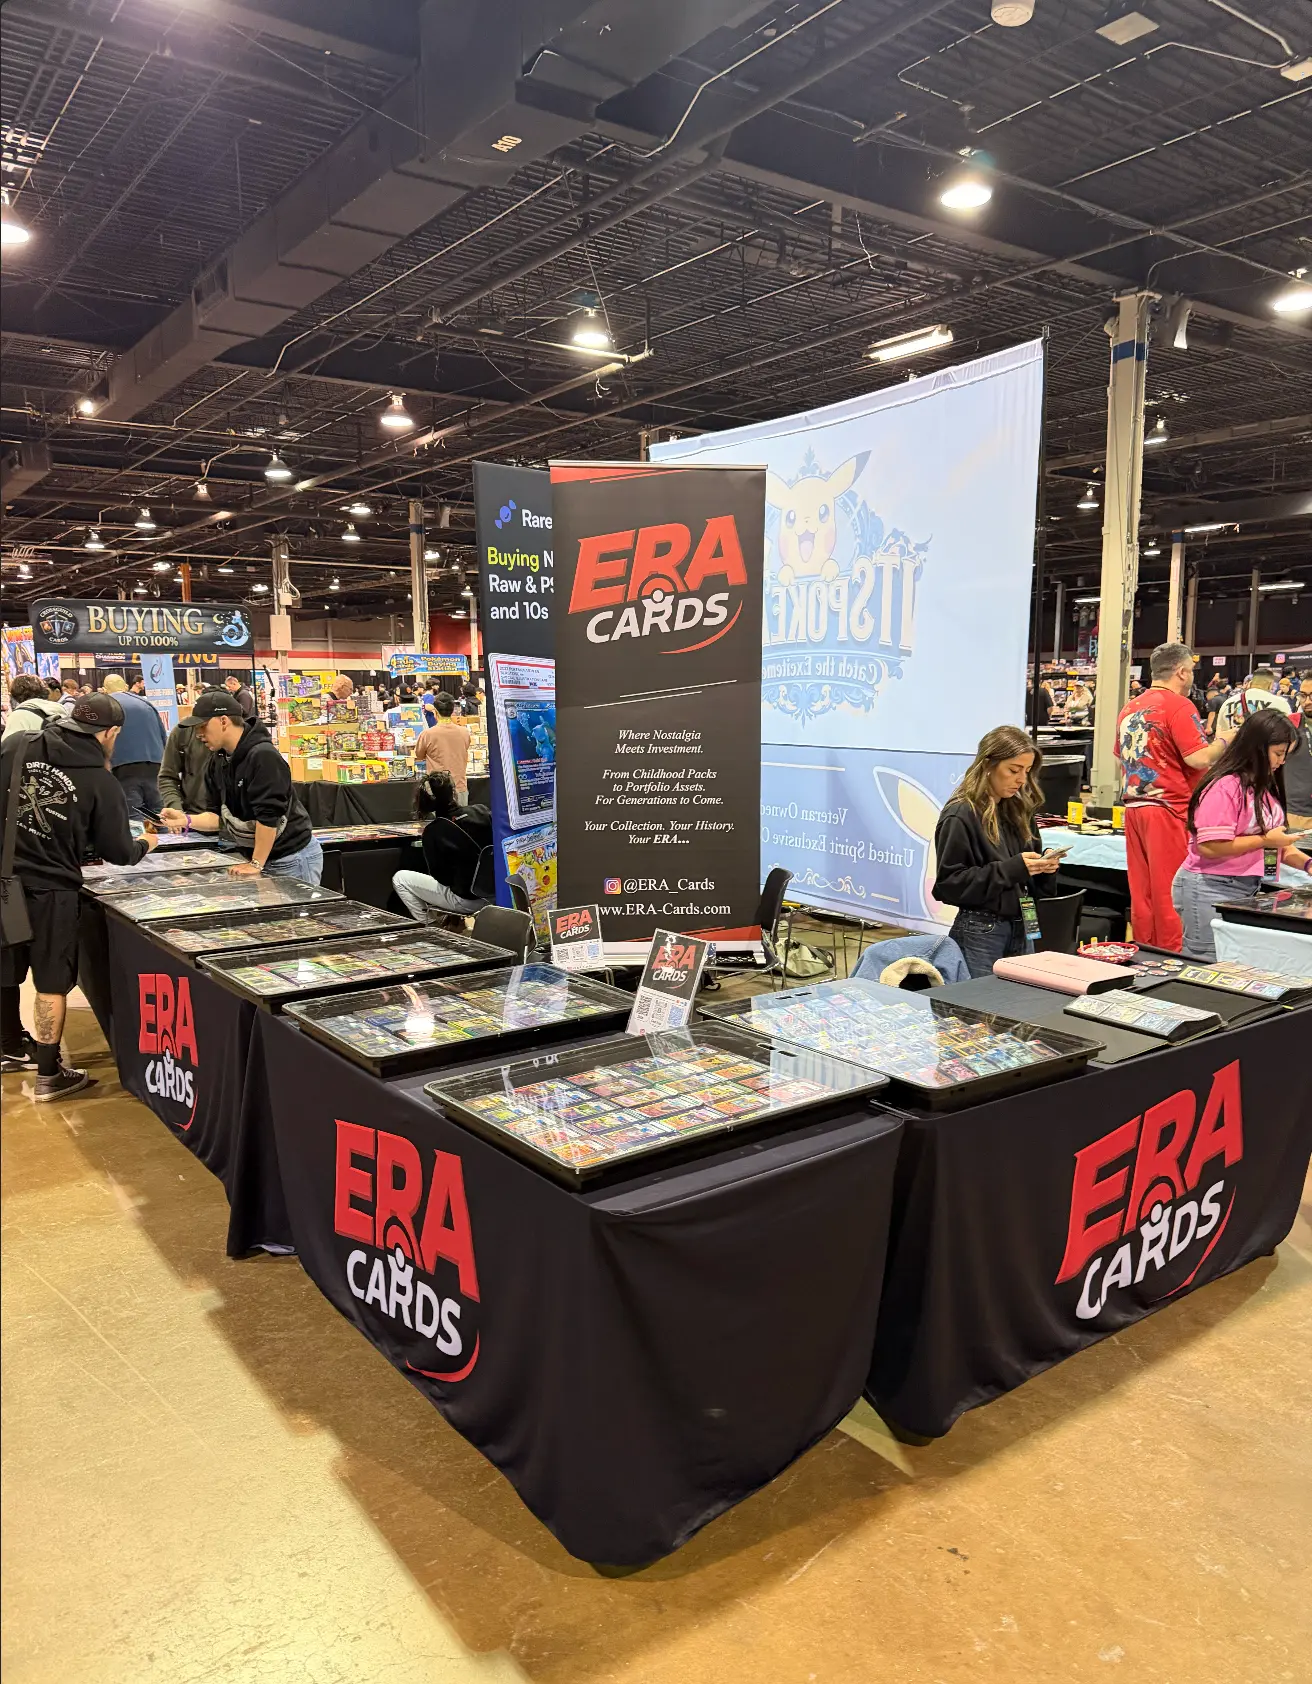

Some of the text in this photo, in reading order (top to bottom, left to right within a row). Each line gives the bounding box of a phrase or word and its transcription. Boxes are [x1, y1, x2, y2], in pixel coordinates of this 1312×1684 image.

[491, 135, 523, 153] A10
[522, 508, 553, 529] Rare
[487, 546, 539, 572] Buying
[567, 514, 748, 615] ERA
[488, 574, 522, 593] Raw
[526, 577, 537, 593] &
[86, 605, 205, 635] BUYING
[490, 602, 549, 620] and 10s
[586, 590, 730, 644] CARDS
[118, 635, 179, 647] UP TO 100%
[618, 729, 702, 742] Where Nostalgia
[614, 743, 704, 754] Meets Investment.
[26, 761, 52, 771] DIRTY
[51, 767, 76, 791] HANDS
[602, 768, 718, 779] From Childhood Packs
[612, 781, 706, 794] to Portfolio Assets.
[595, 794, 724, 805] For Generations to Come.
[584, 820, 735, 832] Your Collection. Your History.
[628, 834, 690, 844] Your ERA...
[623, 878, 715, 894] @ERA_Cards
[600, 903, 732, 916] ww.ERA-Cards.com
[556, 909, 593, 934] ERA
[560, 924, 590, 940] CARDS
[651, 944, 697, 970] ERA
[652, 966, 688, 982] CARDS
[138, 973, 199, 1068] ERA
[145, 1050, 194, 1109] CARDS
[1054, 1058, 1244, 1286] ERA
[334, 1118, 480, 1304] ERA
[1075, 1179, 1225, 1320] CARDS
[346, 1247, 463, 1357] CARDS
